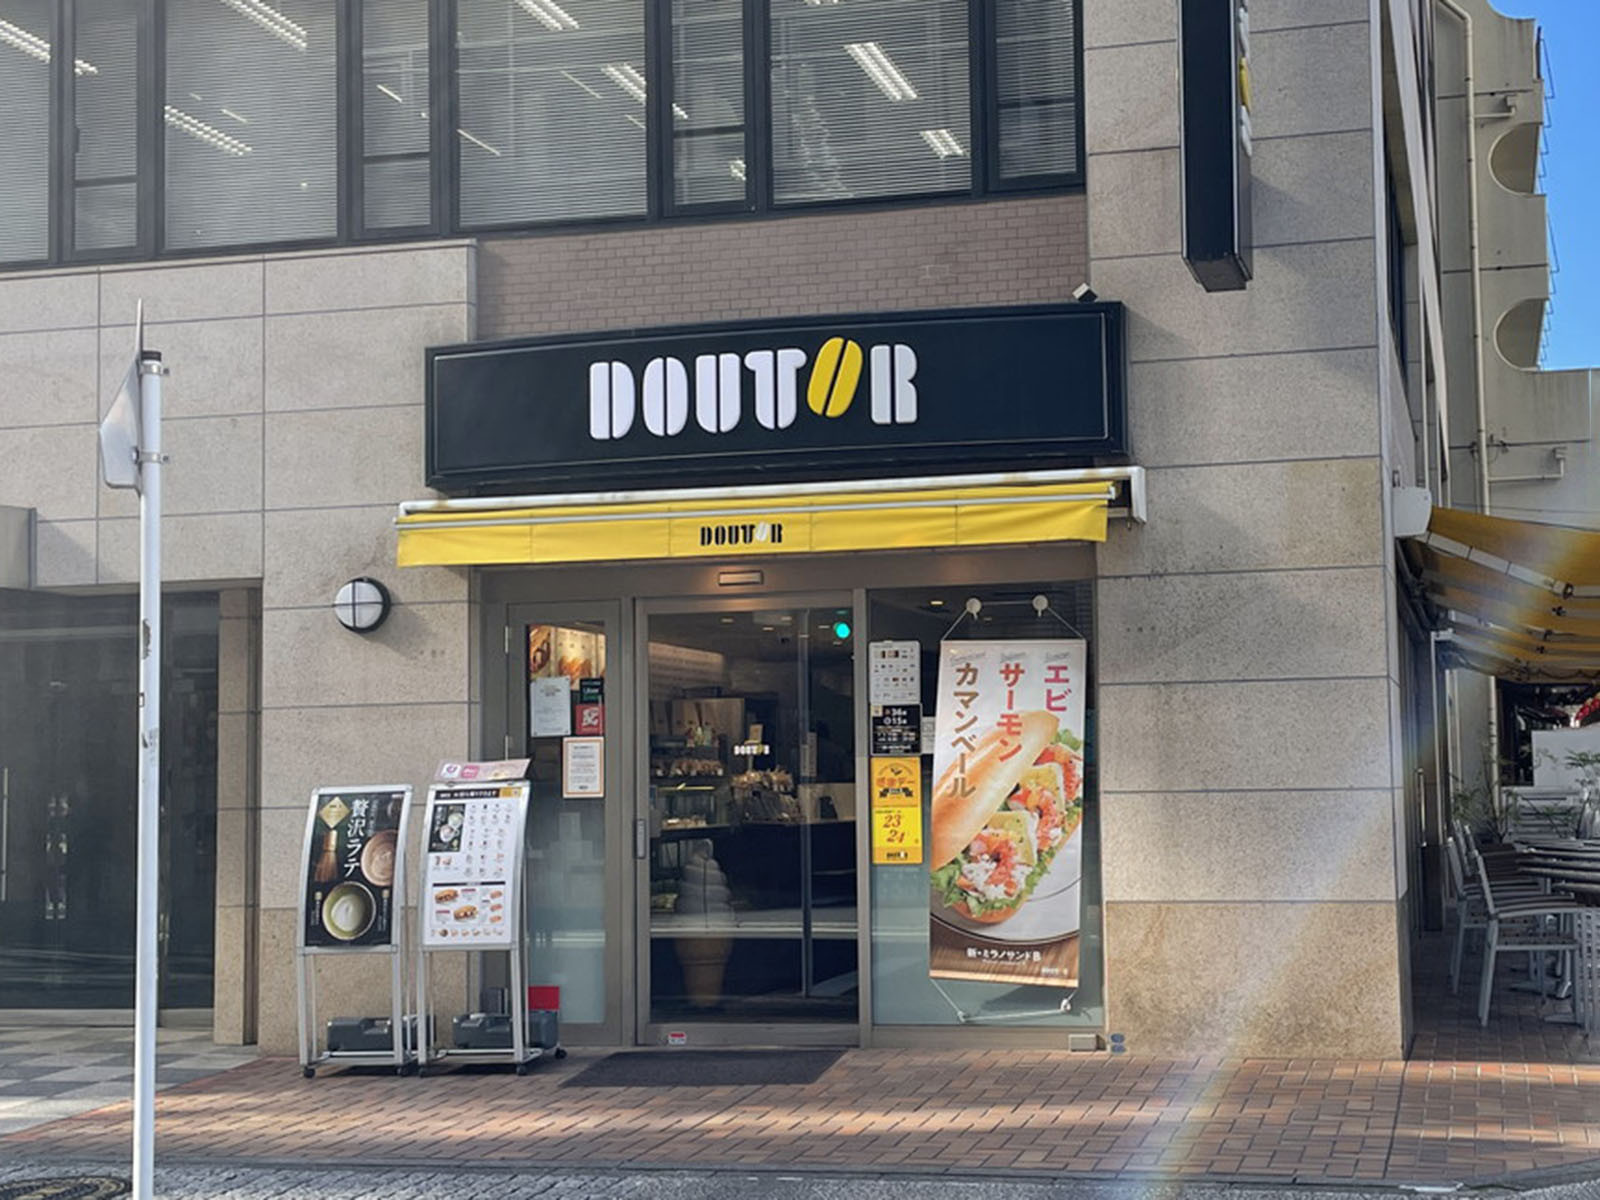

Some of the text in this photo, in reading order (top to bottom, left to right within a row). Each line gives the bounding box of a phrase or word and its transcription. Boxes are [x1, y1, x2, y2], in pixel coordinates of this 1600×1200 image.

[589, 336, 918, 440] DOUTOR
[700, 522, 783, 546] DOUTOR
[996, 662, 1025, 763] サーモン
[1044, 664, 1072, 712] エビ
[951, 662, 980, 799] カマンベール
[343, 798, 370, 878] 贅沢ラテ
[882, 813, 902, 829] 23
